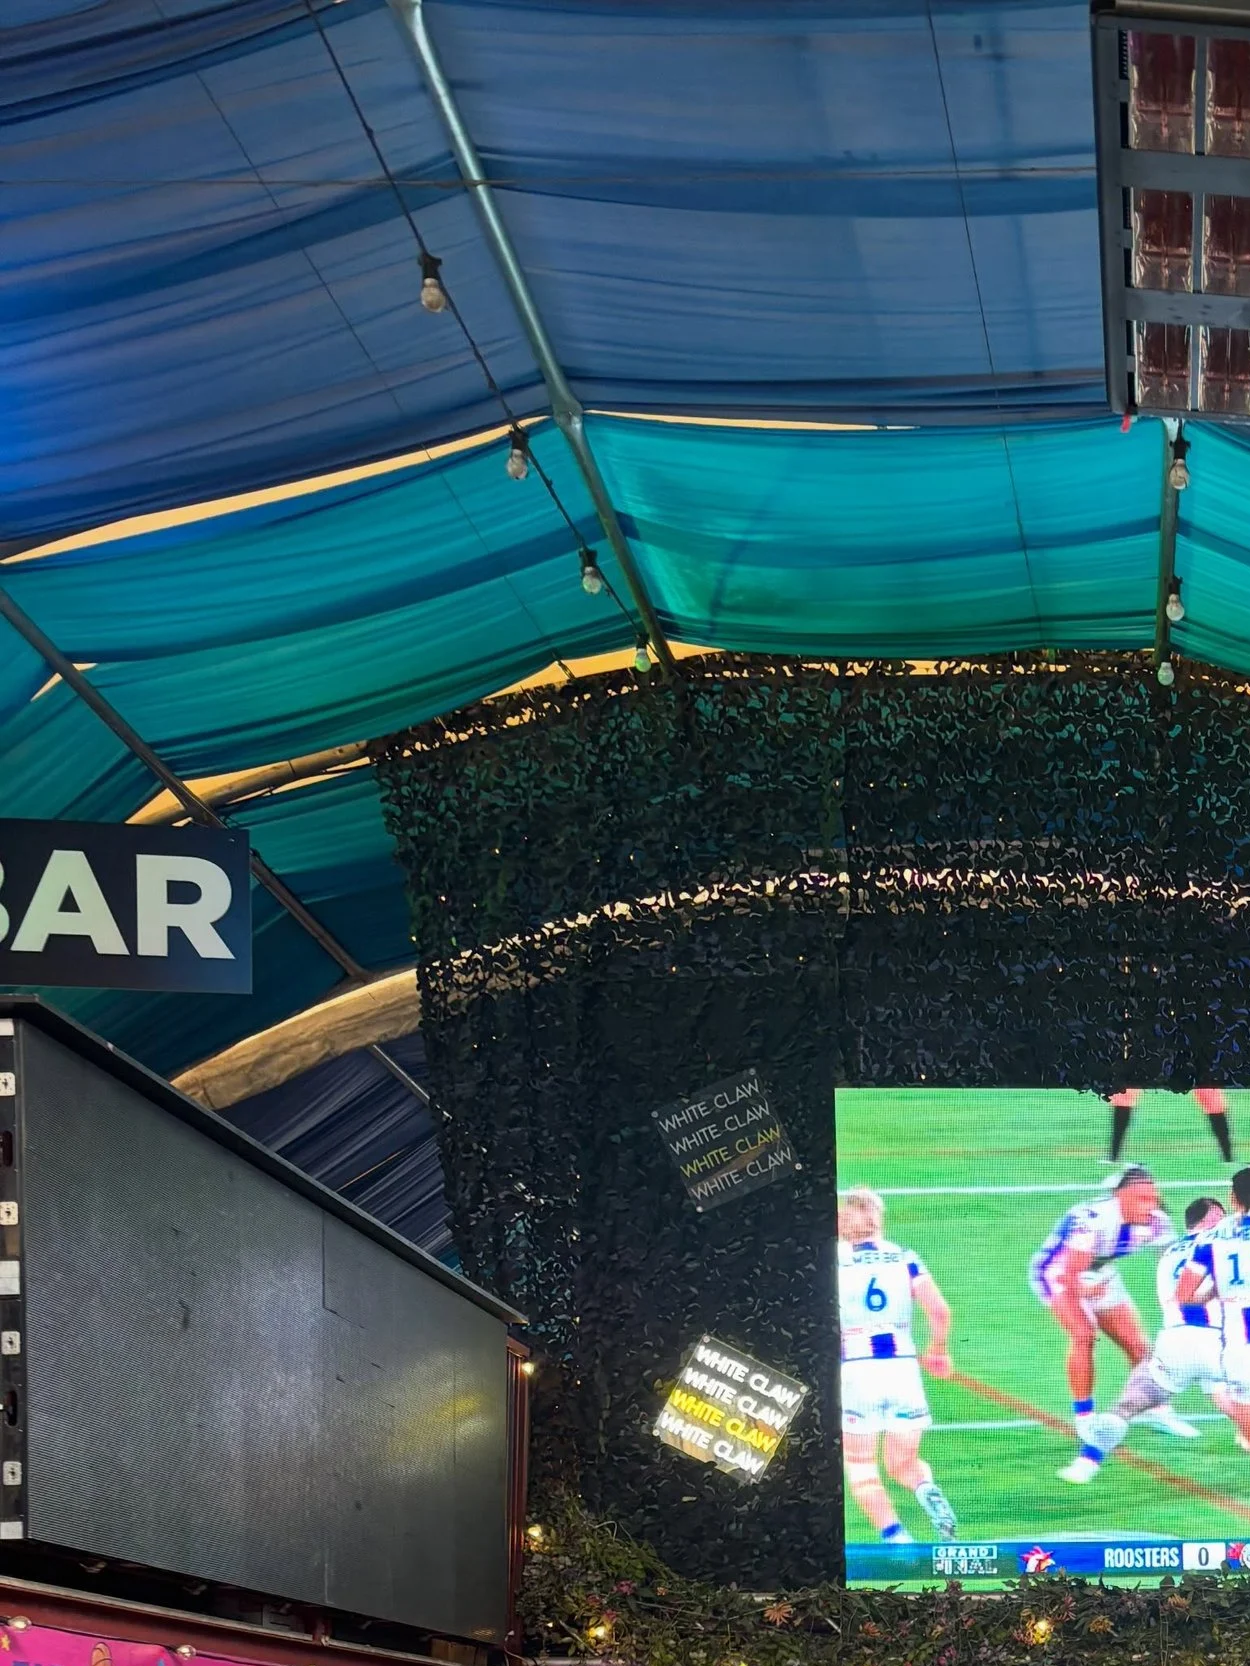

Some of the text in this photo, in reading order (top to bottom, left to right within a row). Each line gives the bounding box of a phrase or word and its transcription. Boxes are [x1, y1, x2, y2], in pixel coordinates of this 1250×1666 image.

[659, 1079, 759, 1133] WHITE CLAW
[670, 1101, 770, 1155] WHITE CLAW
[680, 1124, 780, 1178] WHITE CLAW
[691, 1147, 792, 1200] WHITE CLAW
[865, 1277, 888, 1312] 6
[684, 1367, 788, 1430] WHITE CLAW
[696, 1345, 800, 1408] WHITE CLAW
[660, 1412, 764, 1474] WHITE CLAW
[672, 1390, 776, 1452] WHITE CLAW
[937, 1547, 989, 1558] GRAND
[1104, 1546, 1179, 1569] ROOSTERS
[1198, 1546, 1209, 1567] 0
